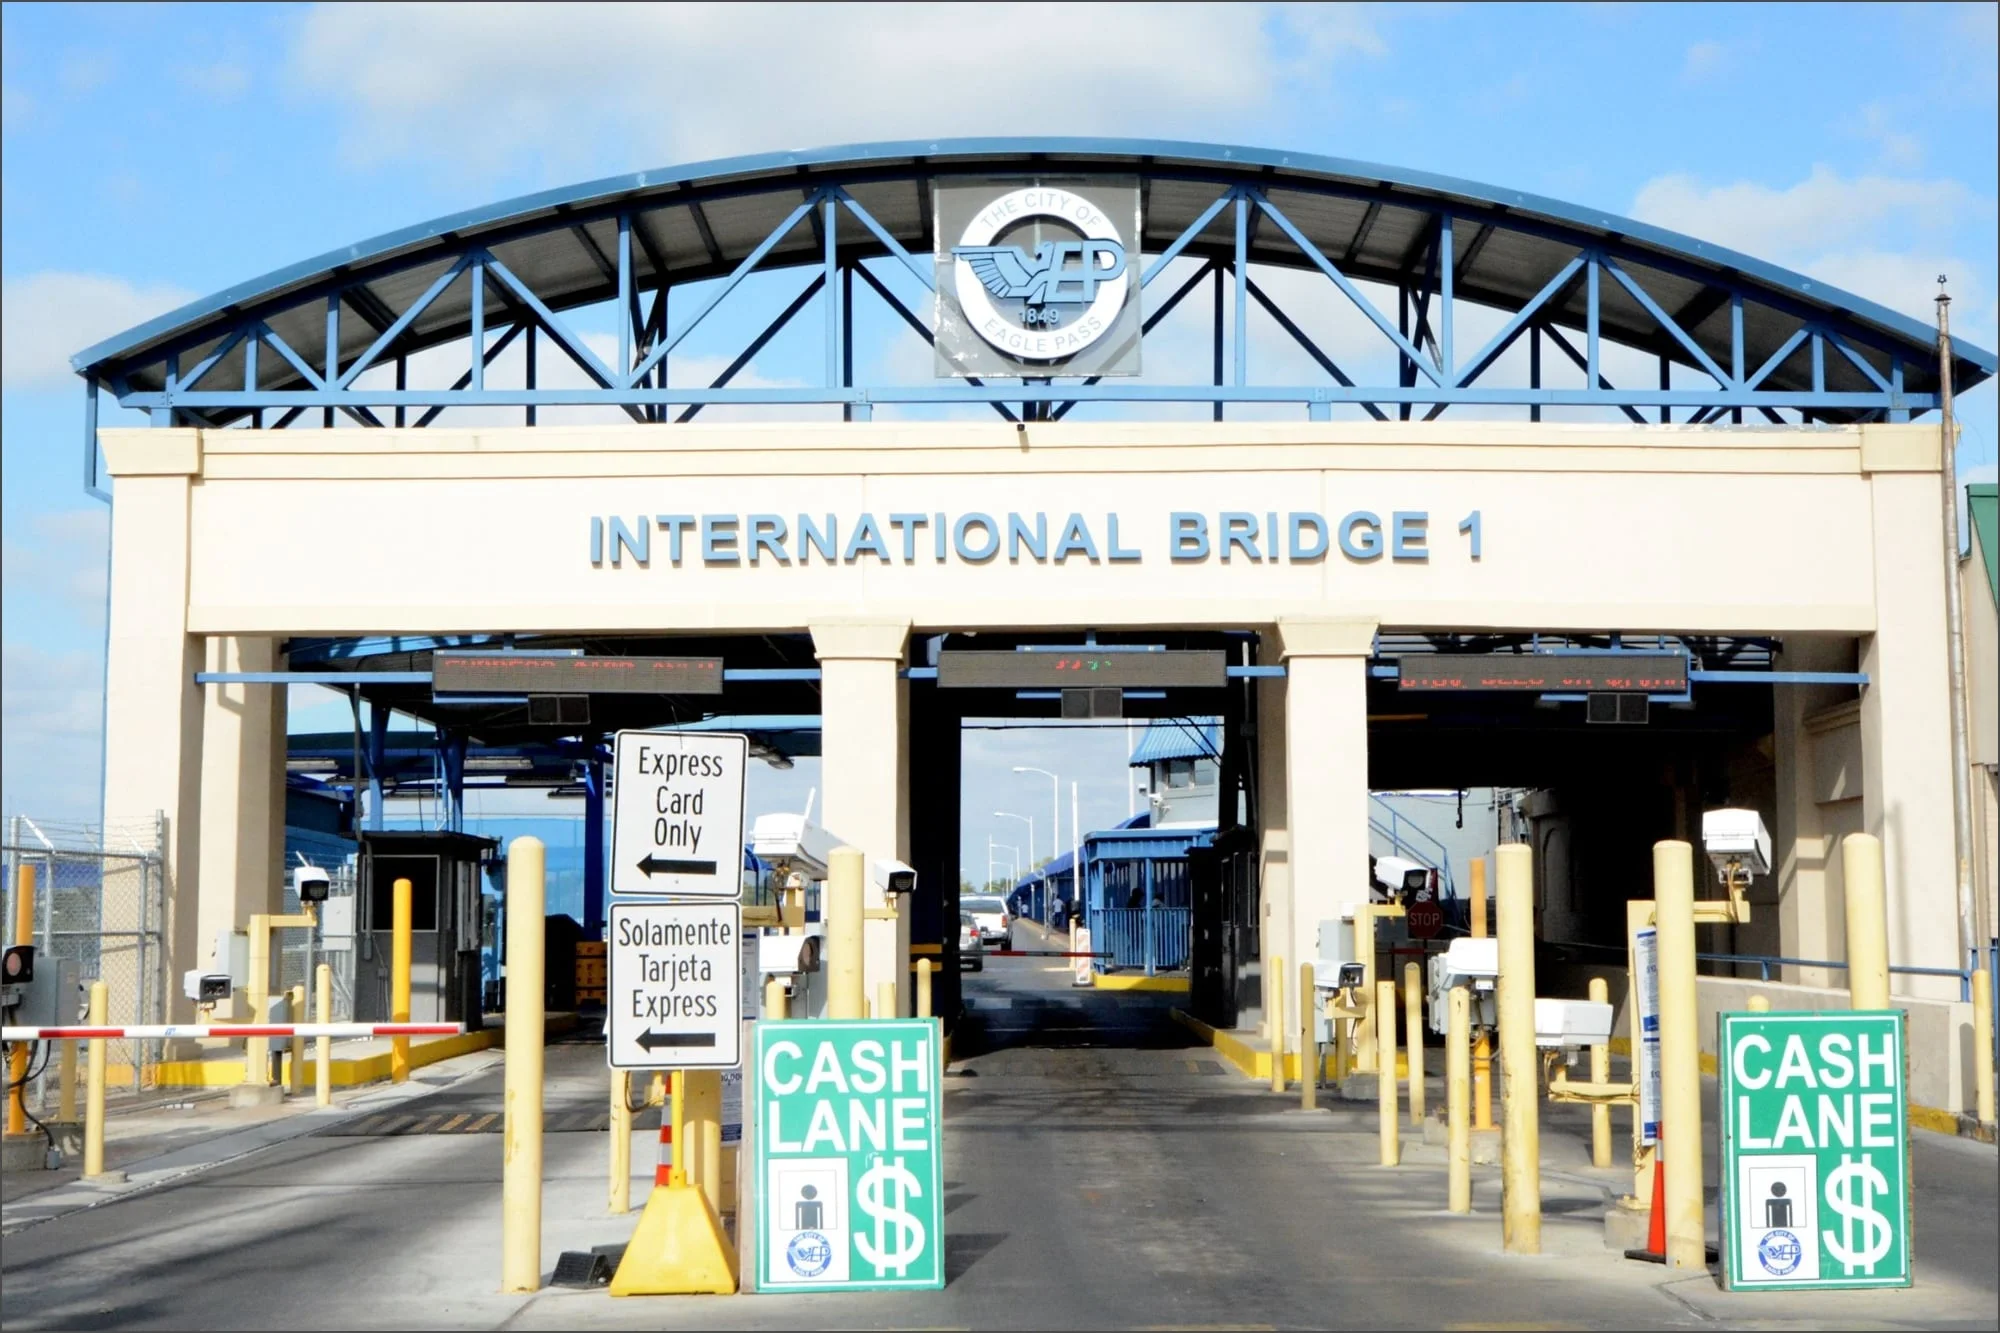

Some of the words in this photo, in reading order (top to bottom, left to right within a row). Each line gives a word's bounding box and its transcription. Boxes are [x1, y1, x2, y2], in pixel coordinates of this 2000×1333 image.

[980, 197, 1018, 230] THE
[1025, 192, 1071, 211] CITY
[1075, 205, 1101, 227] OF
[984, 317, 1047, 353] EAGLE
[1055, 315, 1101, 351] PASS
[1019, 308, 1059, 324] 1849
[590, 511, 1141, 568] INTERNATIONAL
[1169, 510, 1429, 565] BRIDGE
[1459, 510, 1481, 562] 1
[639, 746, 723, 782] Express
[656, 785, 703, 815] Card
[654, 817, 702, 854] Only
[619, 917, 731, 946] Solamente
[1410, 912, 1440, 926] STOP
[639, 953, 711, 992] Tarjeta
[633, 989, 717, 1024] Express
[764, 1040, 928, 1096] CASH
[1733, 1033, 1895, 1090] CASH
[769, 1097, 928, 1153] LANE
[1738, 1093, 1895, 1149] LANE
[853, 1156, 926, 1278] $
[1822, 1153, 1893, 1275] $
